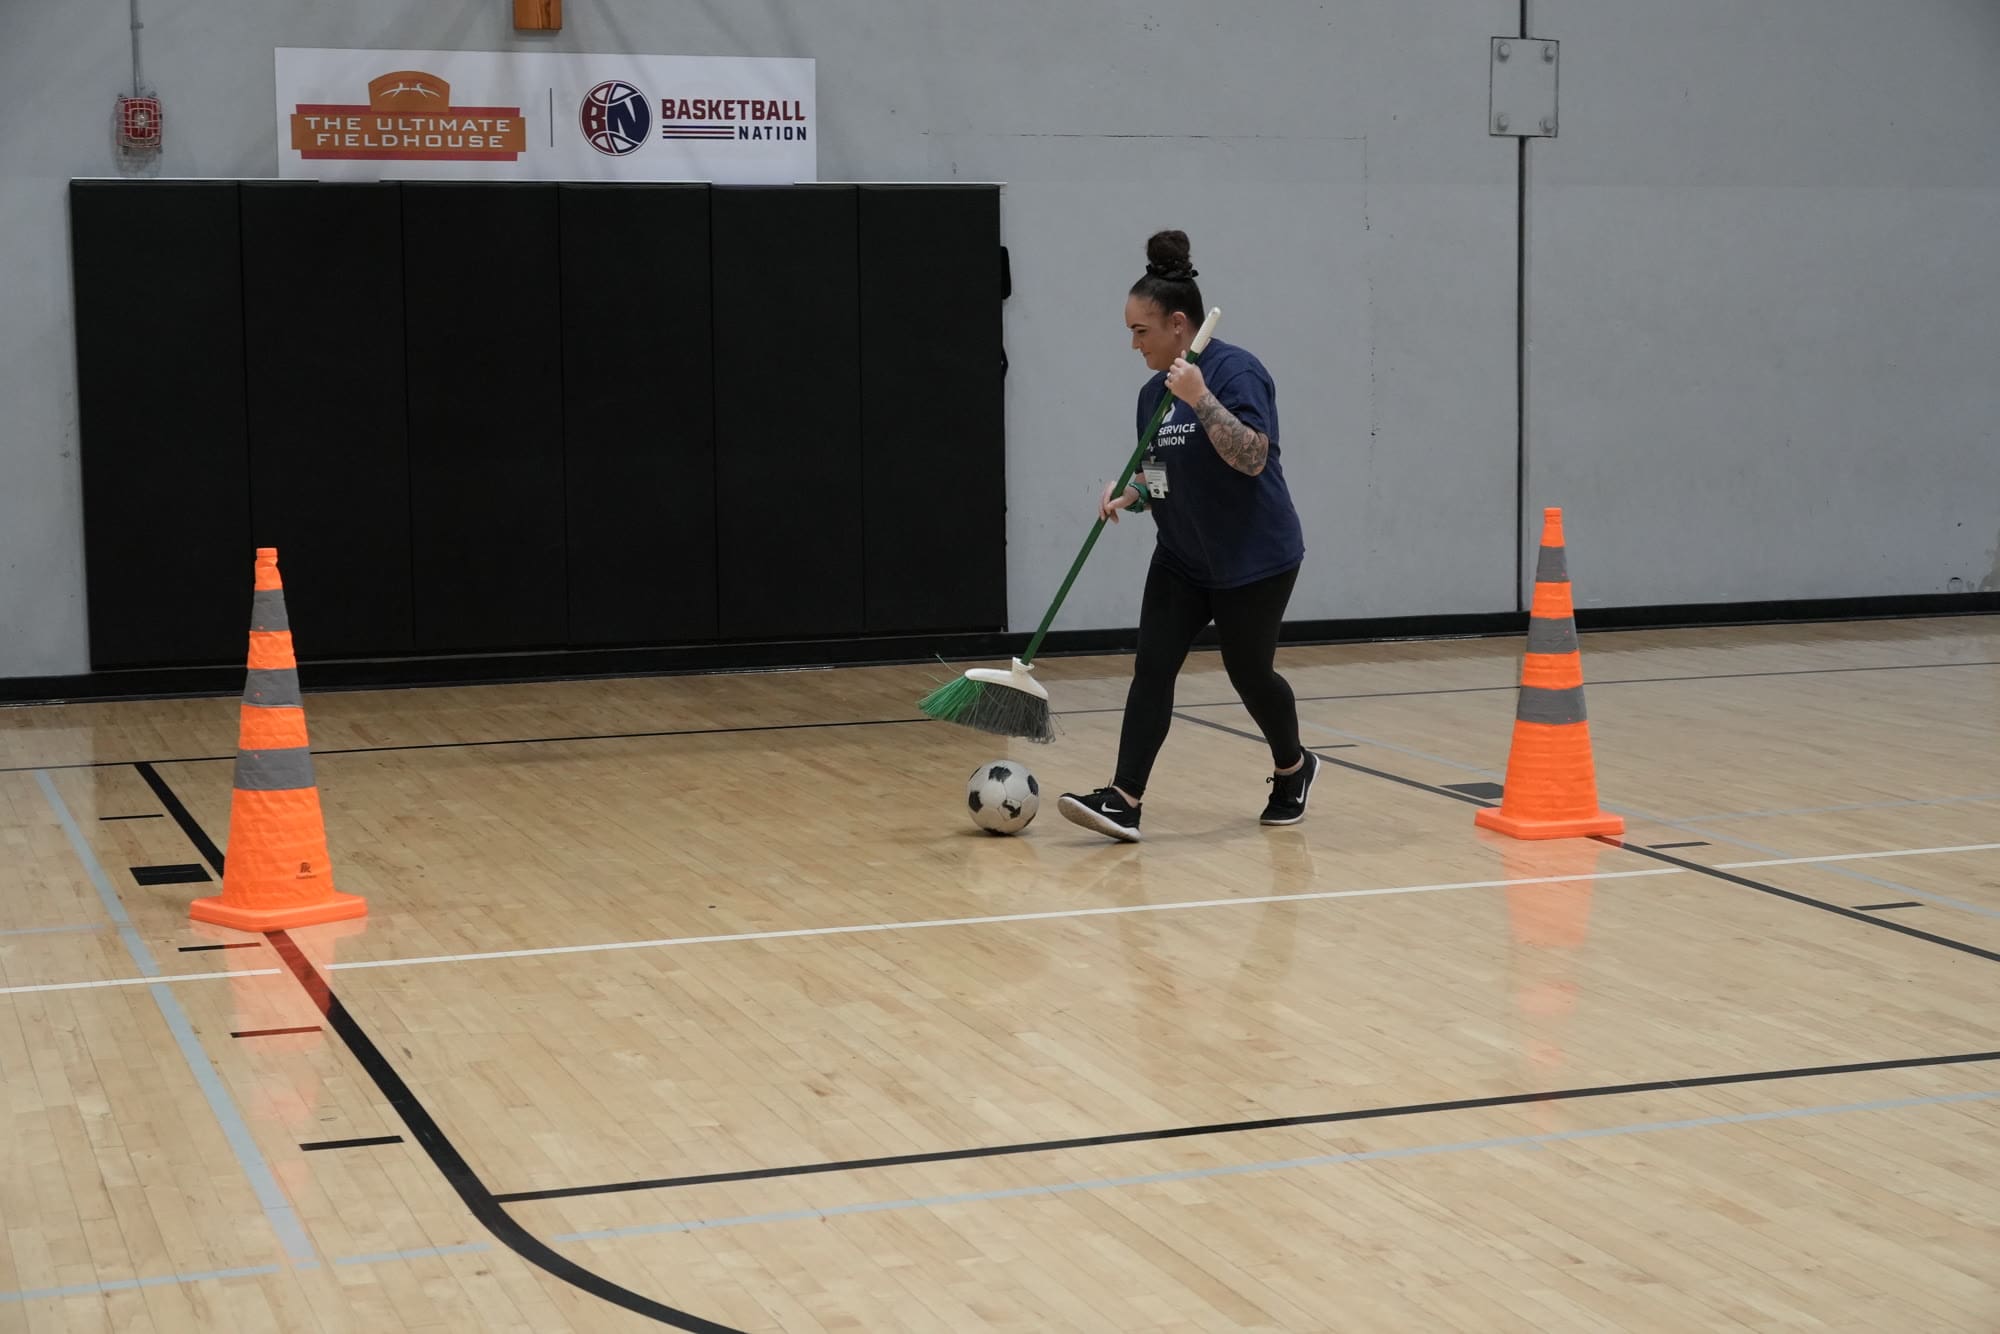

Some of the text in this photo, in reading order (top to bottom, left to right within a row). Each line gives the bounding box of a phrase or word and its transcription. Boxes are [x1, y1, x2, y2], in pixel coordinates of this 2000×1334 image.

[661, 98, 807, 121] BASKETBALL
[304, 116, 512, 133] THE ULTIMATE
[316, 132, 504, 149] FIELDHOUSE
[738, 125, 808, 142] NATION
[1158, 423, 1196, 436] SERVICE
[1158, 435, 1185, 447] UNION
